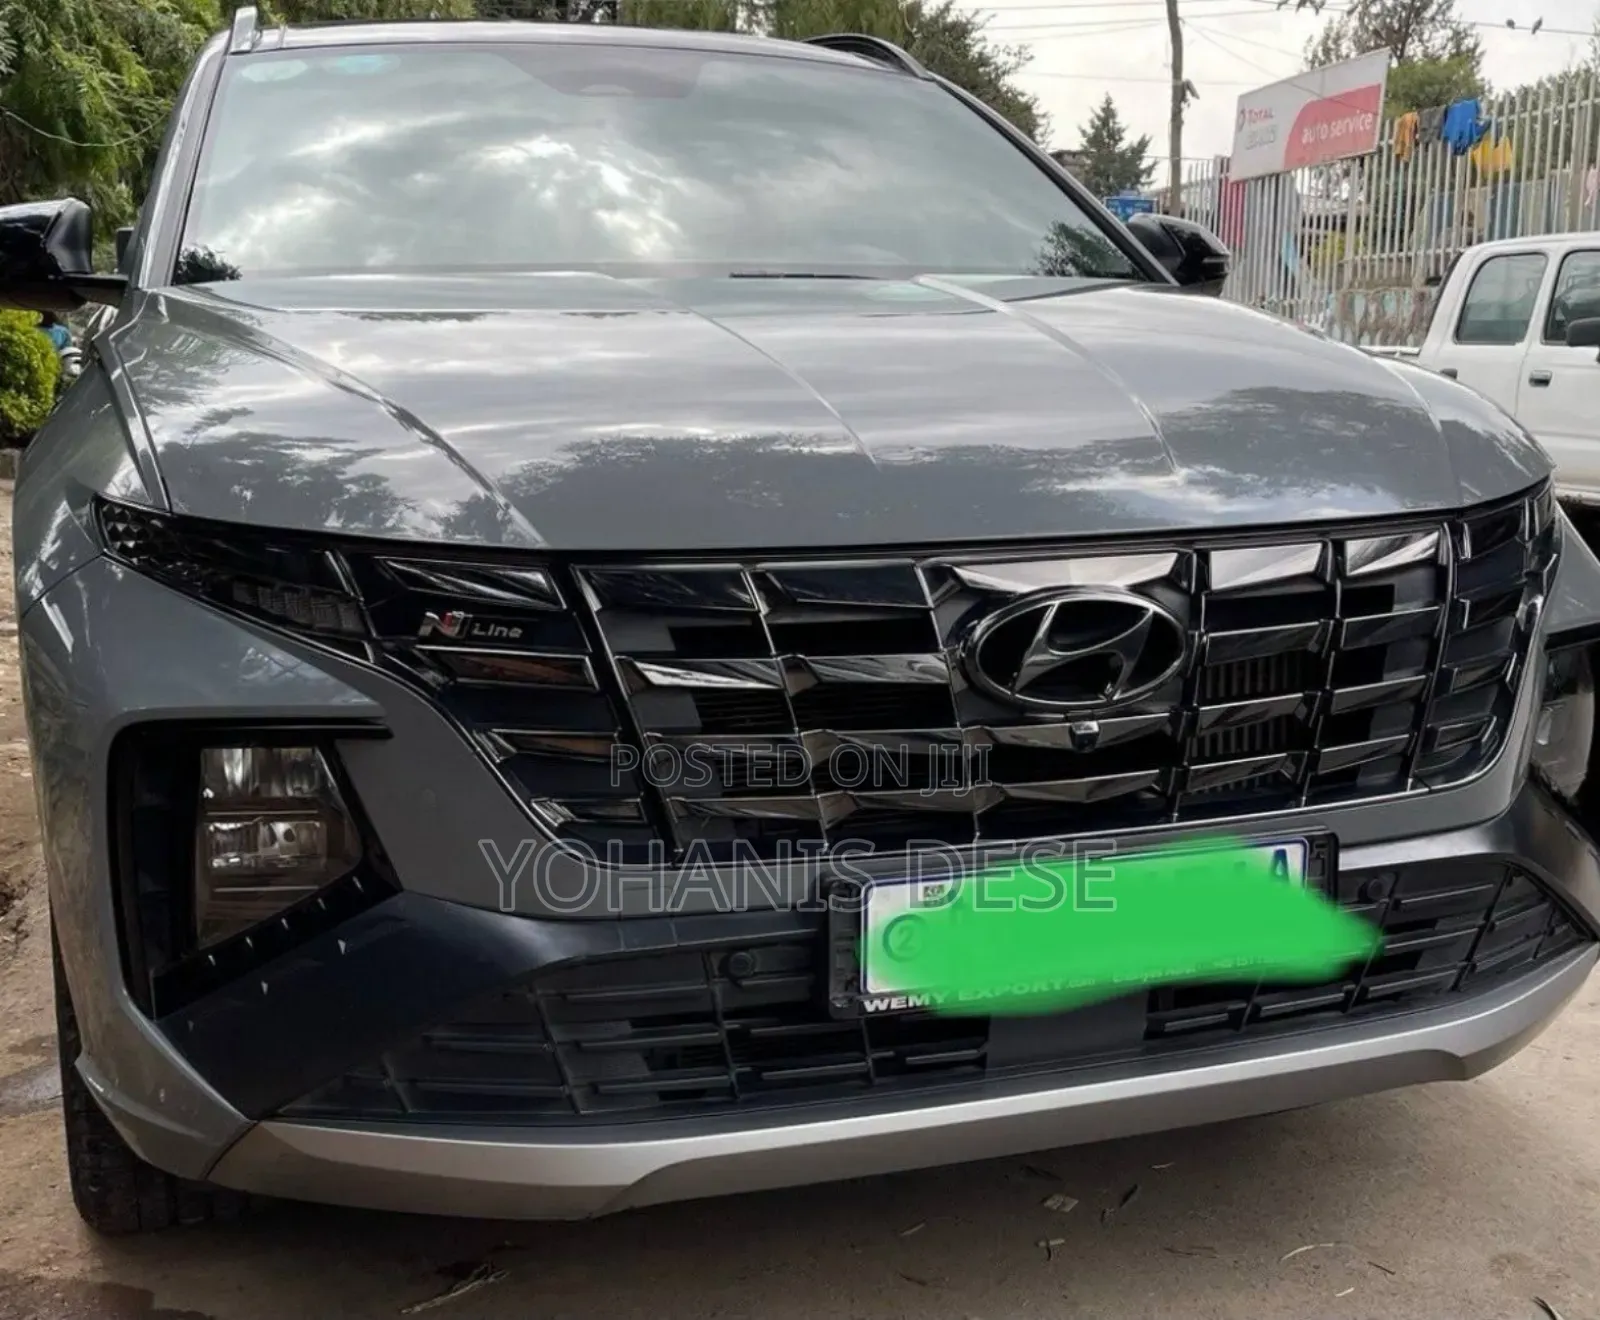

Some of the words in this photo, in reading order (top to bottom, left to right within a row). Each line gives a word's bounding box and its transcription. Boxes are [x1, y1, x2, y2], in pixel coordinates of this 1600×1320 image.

[1301, 123, 1329, 145] auto
[1330, 109, 1373, 137] service
[863, 990, 948, 1013] WEMY
